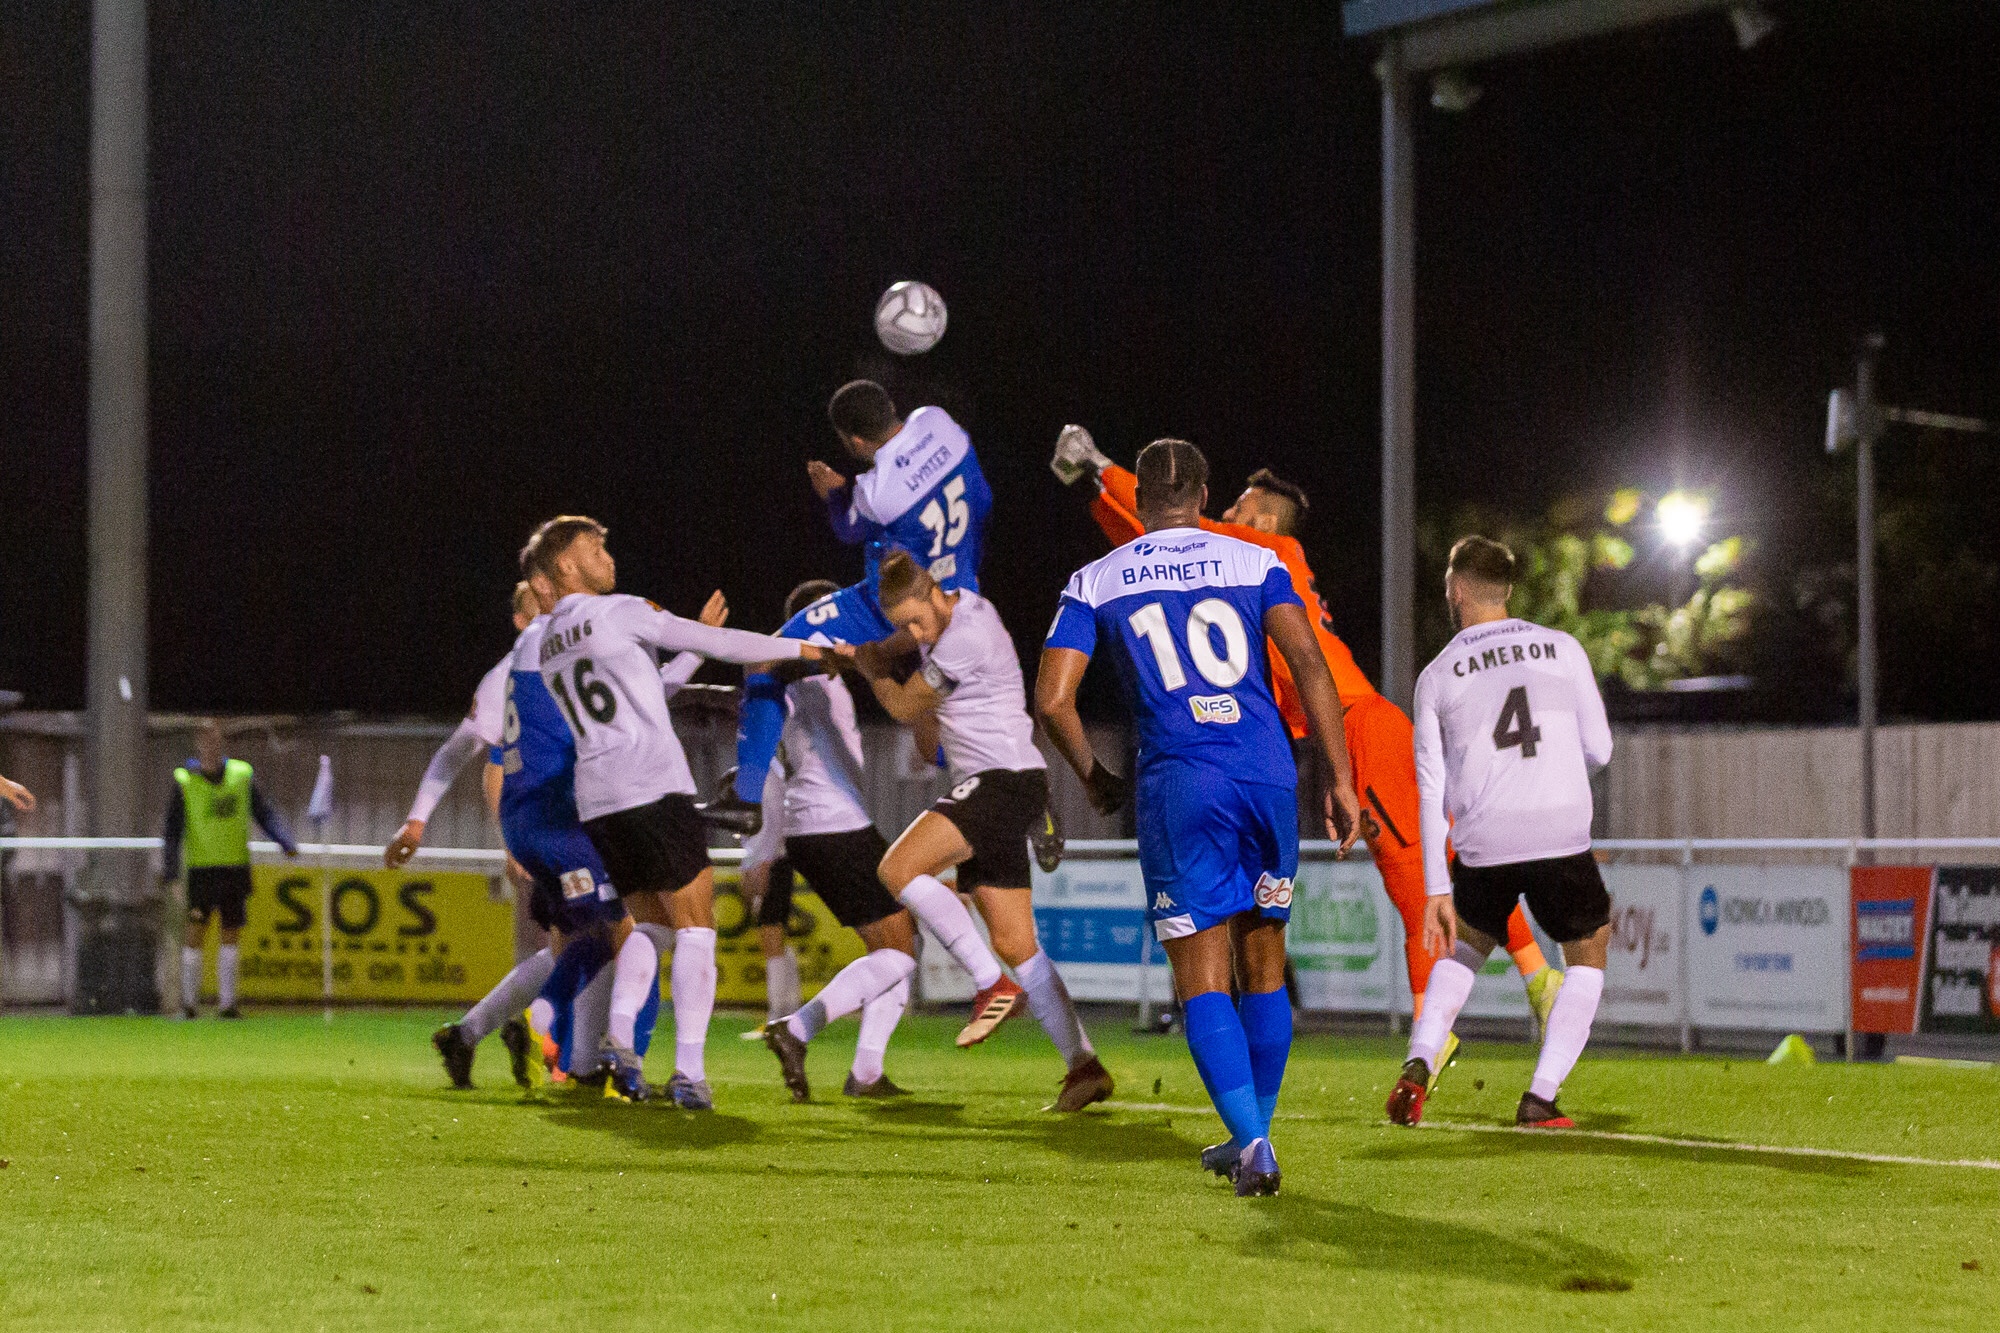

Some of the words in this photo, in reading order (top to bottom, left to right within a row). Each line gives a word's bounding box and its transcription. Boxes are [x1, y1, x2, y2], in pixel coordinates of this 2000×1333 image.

[1158, 542, 1208, 555] Polystar
[1122, 560, 1222, 585] BARNETT
[1128, 597, 1249, 692] 10
[1453, 643, 1556, 677] CAMERON
[553, 658, 617, 738] 16
[1196, 699, 1233, 714] VFS
[1492, 685, 1541, 758] 4
[275, 877, 437, 937] SOS
